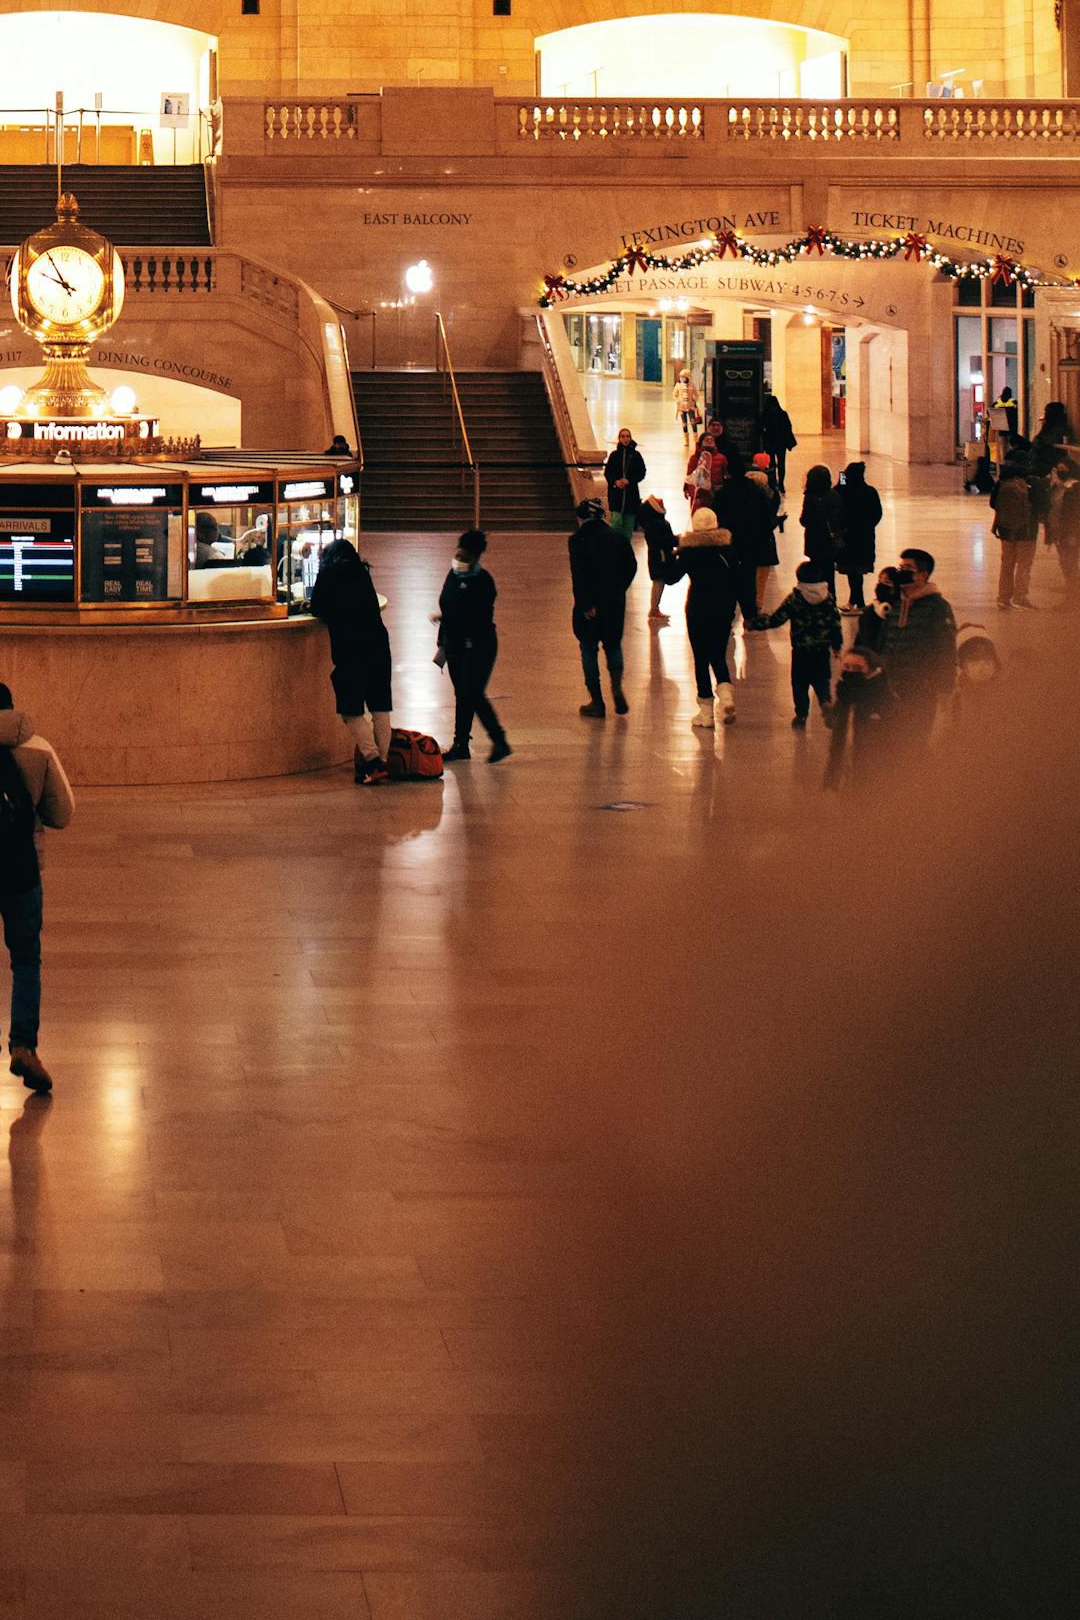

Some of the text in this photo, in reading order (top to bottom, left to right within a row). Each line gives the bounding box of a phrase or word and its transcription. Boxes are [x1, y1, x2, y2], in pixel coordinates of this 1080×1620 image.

[364, 213, 473, 225] EAST BALCONY
[621, 211, 781, 249] LEXINGTON AVE
[852, 211, 1026, 255] TICKET MACHINES
[639, 277, 709, 291] PASSAGE
[717, 277, 789, 295] SUBWAY
[6, 350, 23, 362] 117
[98, 352, 233, 389] DINING CONCOURSE
[33, 422, 125, 441] Information
